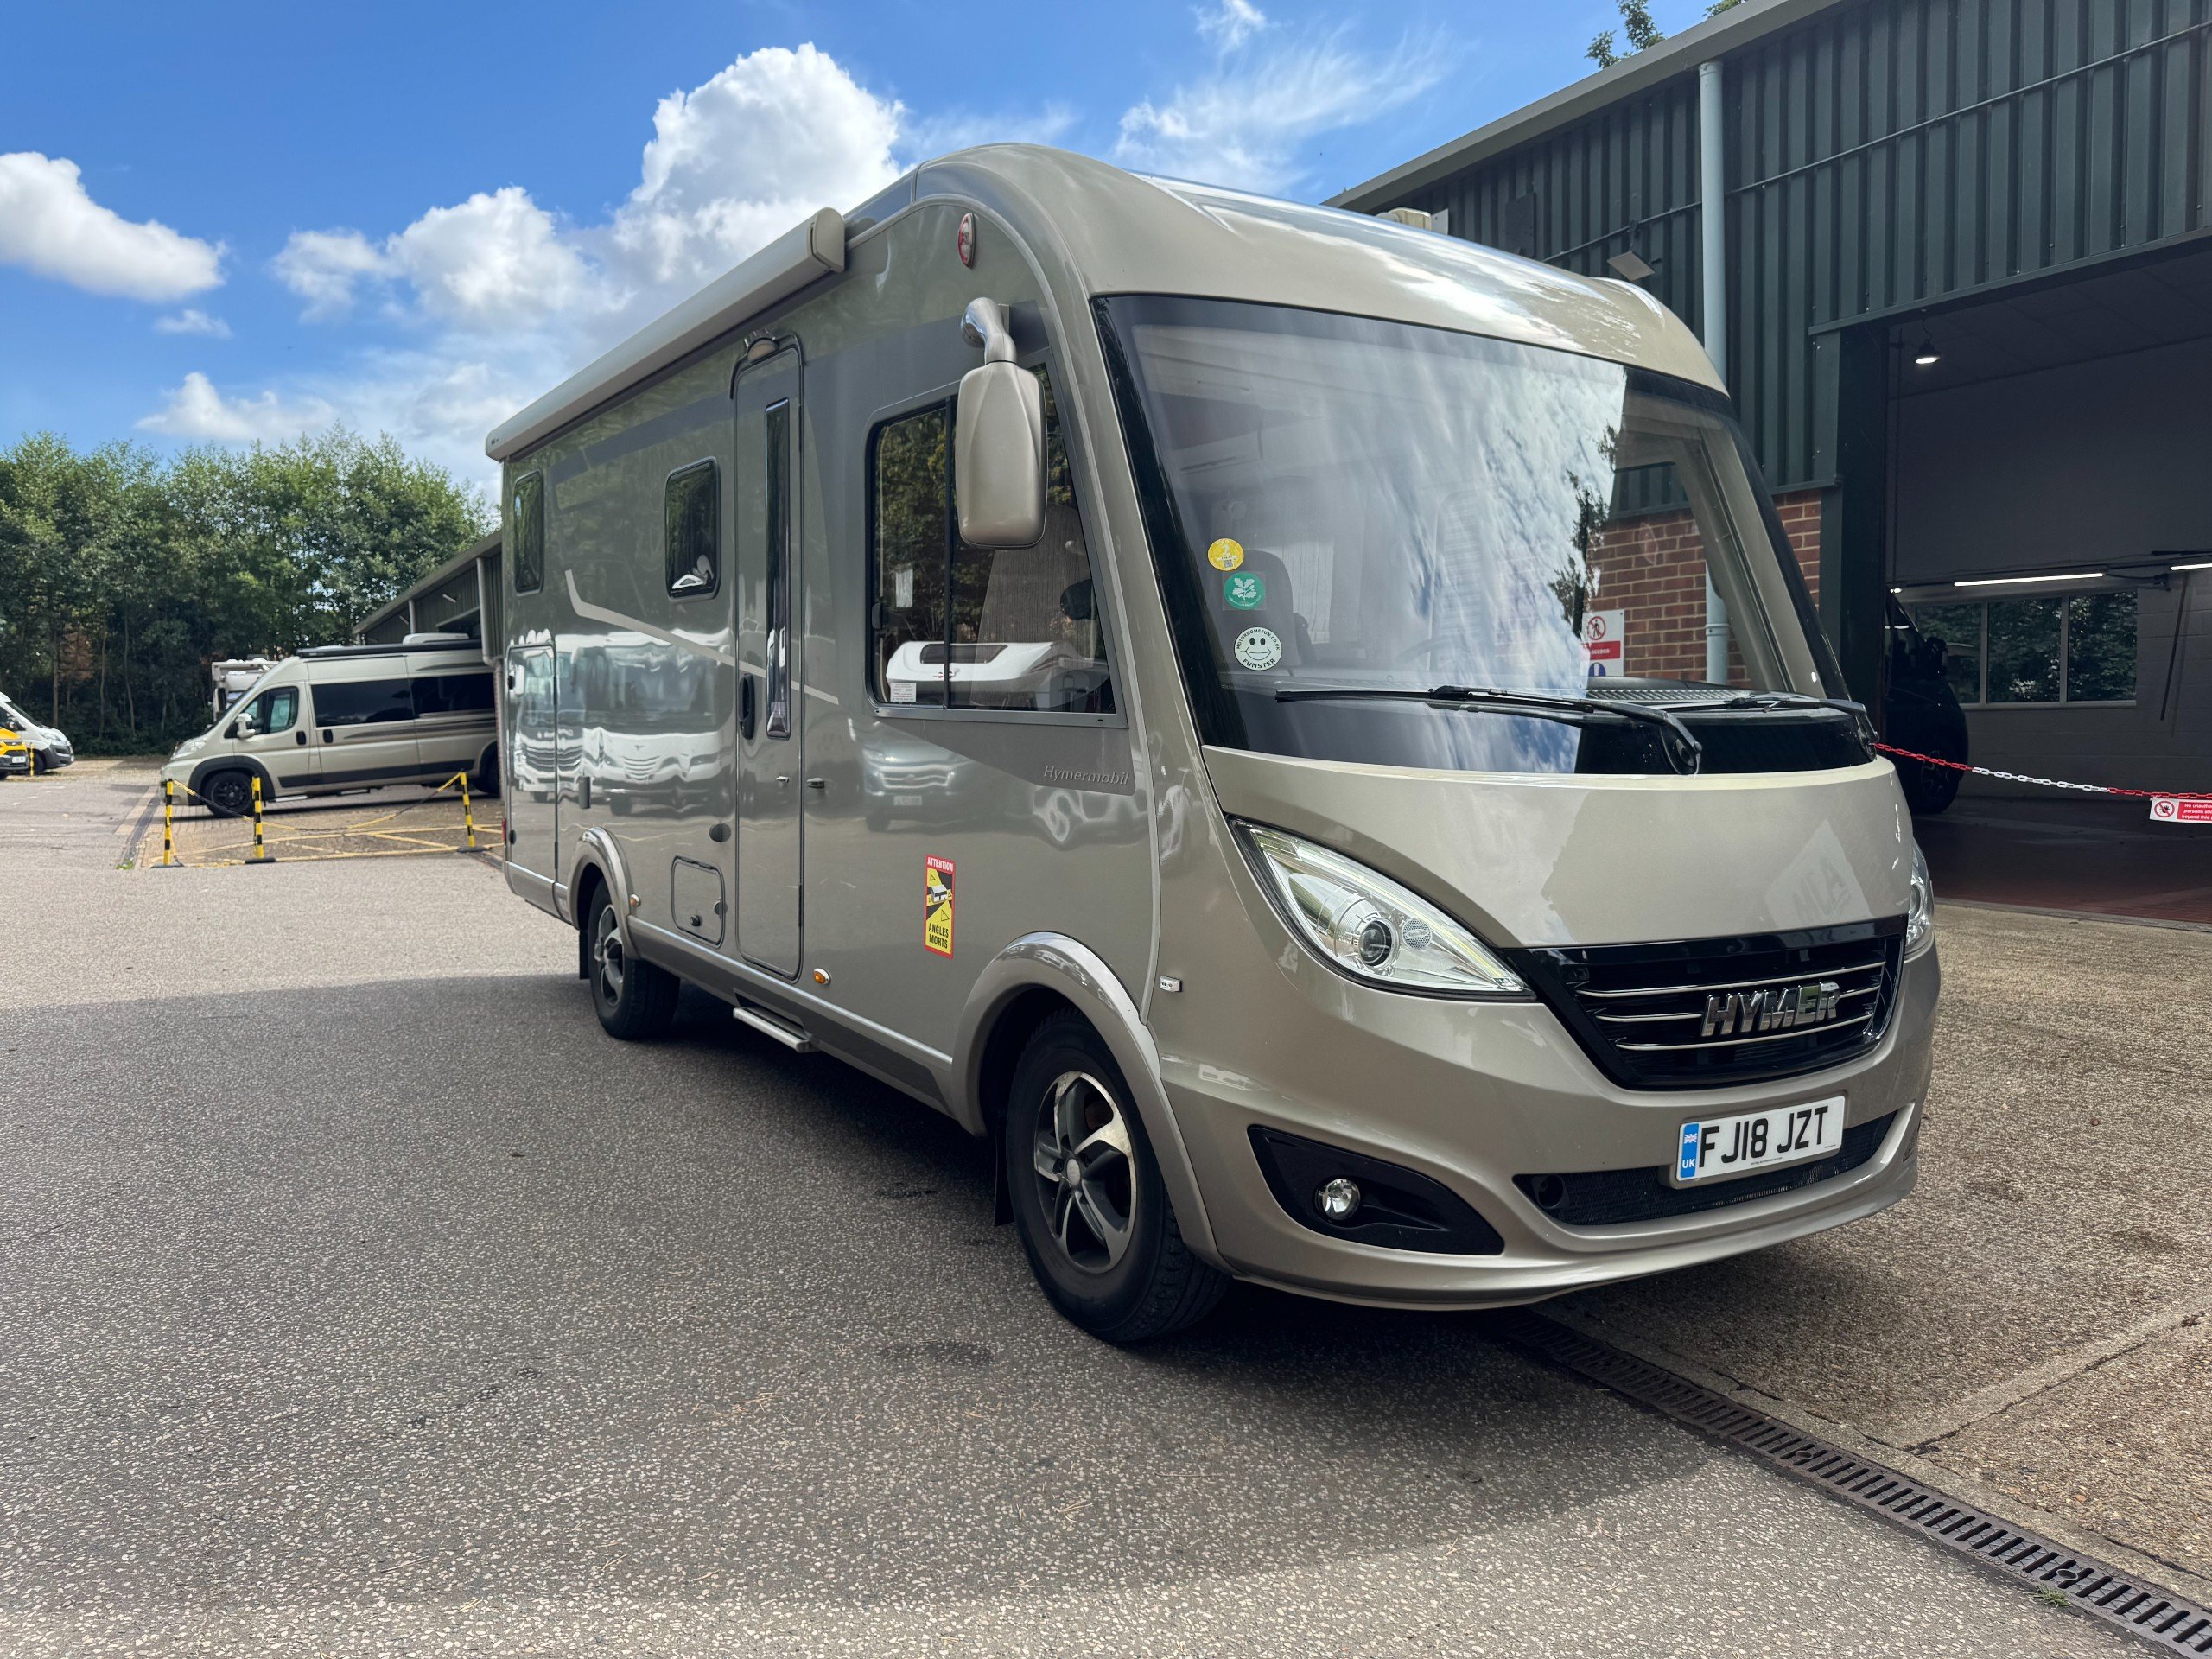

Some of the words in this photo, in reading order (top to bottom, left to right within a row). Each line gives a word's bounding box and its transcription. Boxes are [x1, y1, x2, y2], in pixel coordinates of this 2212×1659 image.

[1236, 628, 1281, 651] MOTORHOMEFUN.CO.UK
[1243, 658, 1276, 669] FUNSTER
[1044, 765, 1130, 785] Hymermobil
[927, 856, 953, 872] ATTENTION
[928, 923, 949, 938] ANGLES
[929, 933, 948, 949] MORTS
[1700, 981, 1841, 1037] HYMER
[1699, 1117, 1769, 1168] FJ18
[1777, 1105, 1829, 1154] JZT
[1681, 1158, 1695, 1170] UK
